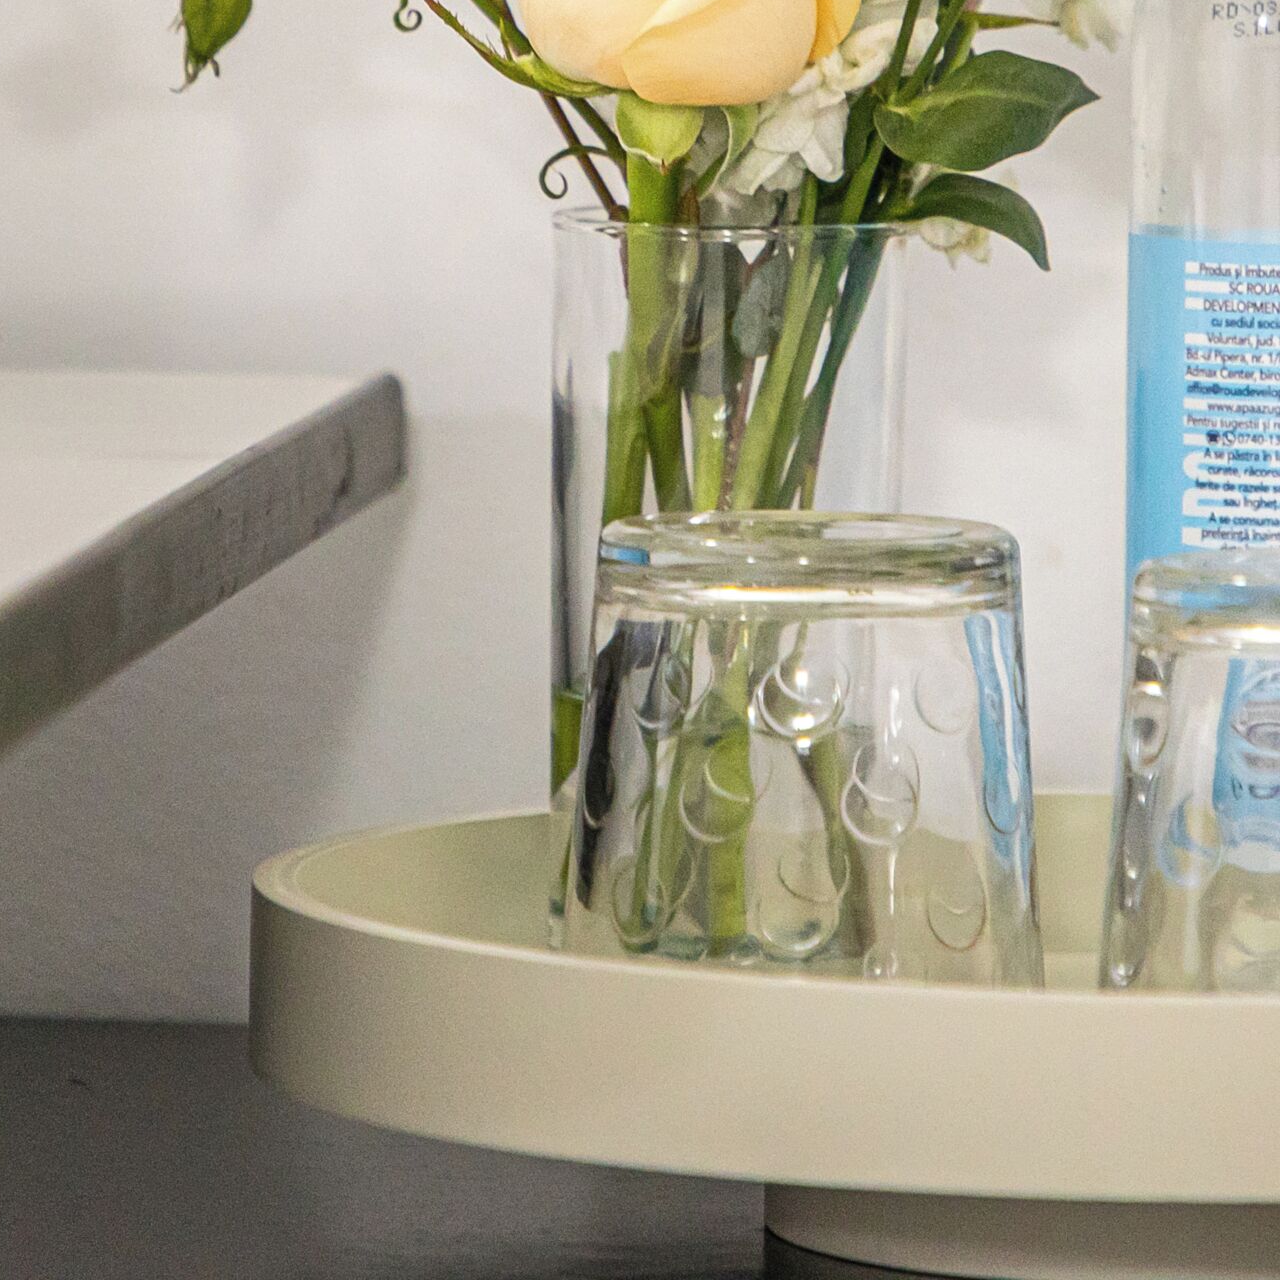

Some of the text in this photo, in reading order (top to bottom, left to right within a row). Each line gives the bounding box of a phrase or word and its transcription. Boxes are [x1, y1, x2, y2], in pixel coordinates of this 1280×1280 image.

[1199, 262, 1231, 276] Produs
[1229, 282, 1280, 296] SC ROUA
[1211, 319, 1222, 328] cu
[1225, 318, 1254, 328] sediul
[1252, 355, 1264, 364] nr.
[1187, 414, 1216, 427] Pentru
[1204, 448, 1215, 458] A
[1216, 450, 1224, 459] se
[1223, 481, 1235, 491] de
[1224, 498, 1240, 507] sau
[1209, 512, 1216, 522] A
[1221, 515, 1230, 524] se
[1233, 516, 1280, 526] consuma
